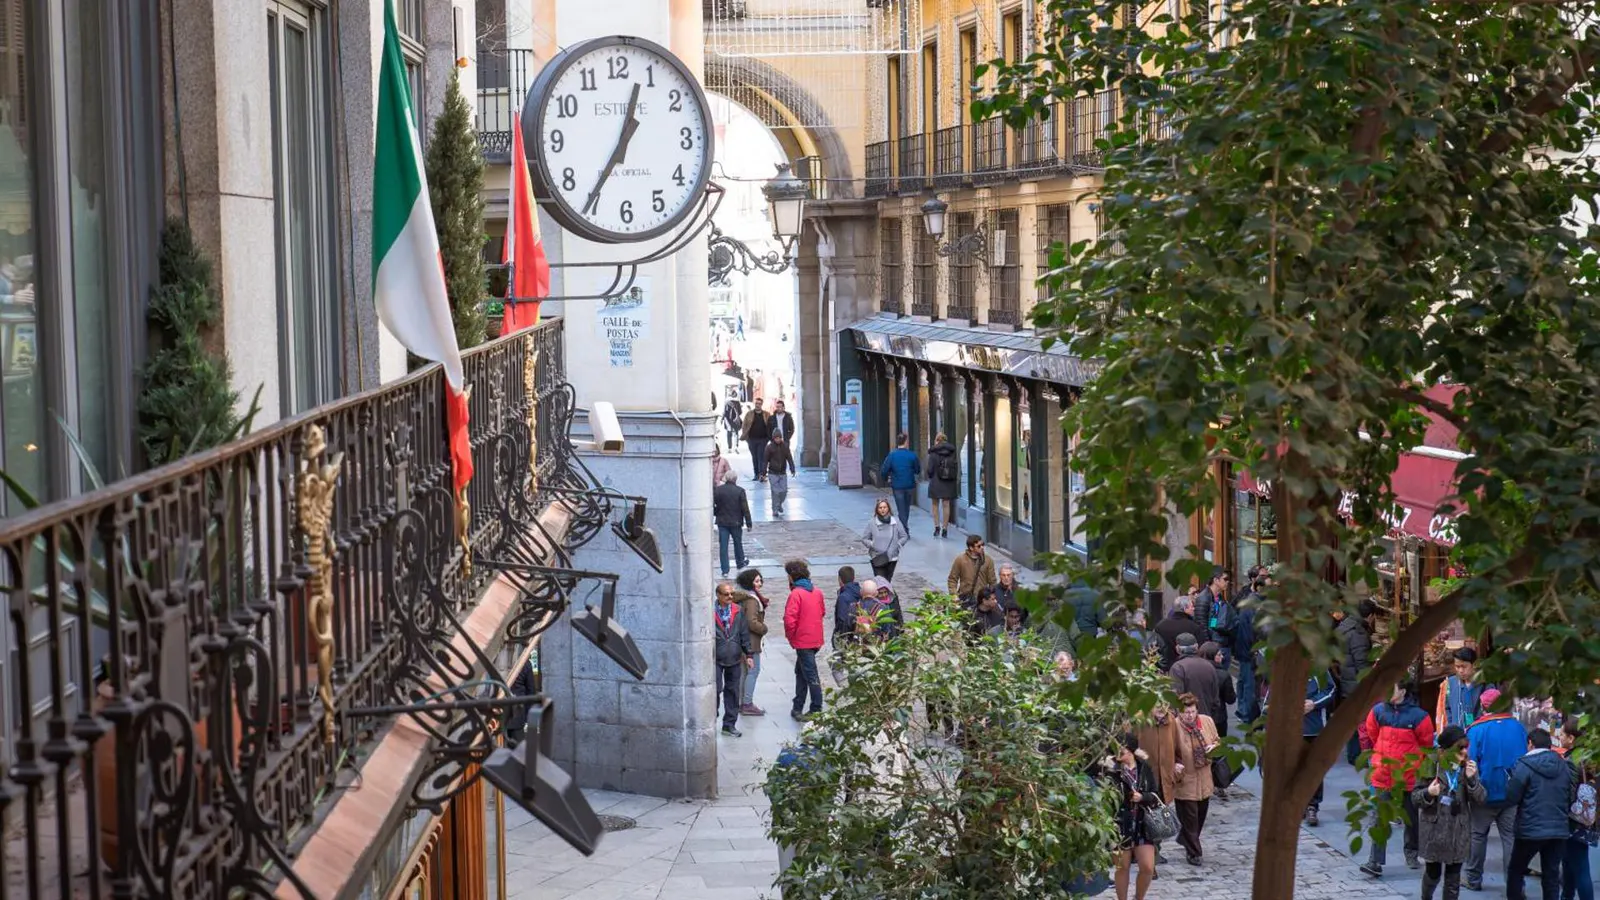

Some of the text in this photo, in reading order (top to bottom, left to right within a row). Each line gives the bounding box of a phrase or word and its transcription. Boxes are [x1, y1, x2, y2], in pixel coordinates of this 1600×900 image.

[580, 67, 598, 91] 11
[606, 56, 630, 80] 12
[646, 65, 656, 88] 1
[556, 94, 578, 118] 10
[594, 101, 649, 117] ESTIE
[668, 89, 683, 112] 2
[550, 129, 564, 153] 9
[680, 127, 693, 150] 3
[562, 167, 576, 191] 8
[672, 164, 686, 187] 4
[620, 200, 634, 224] 6
[652, 189, 666, 212] 5
[603, 316, 629, 327] CALLE
[607, 328, 640, 339] POSTAS
